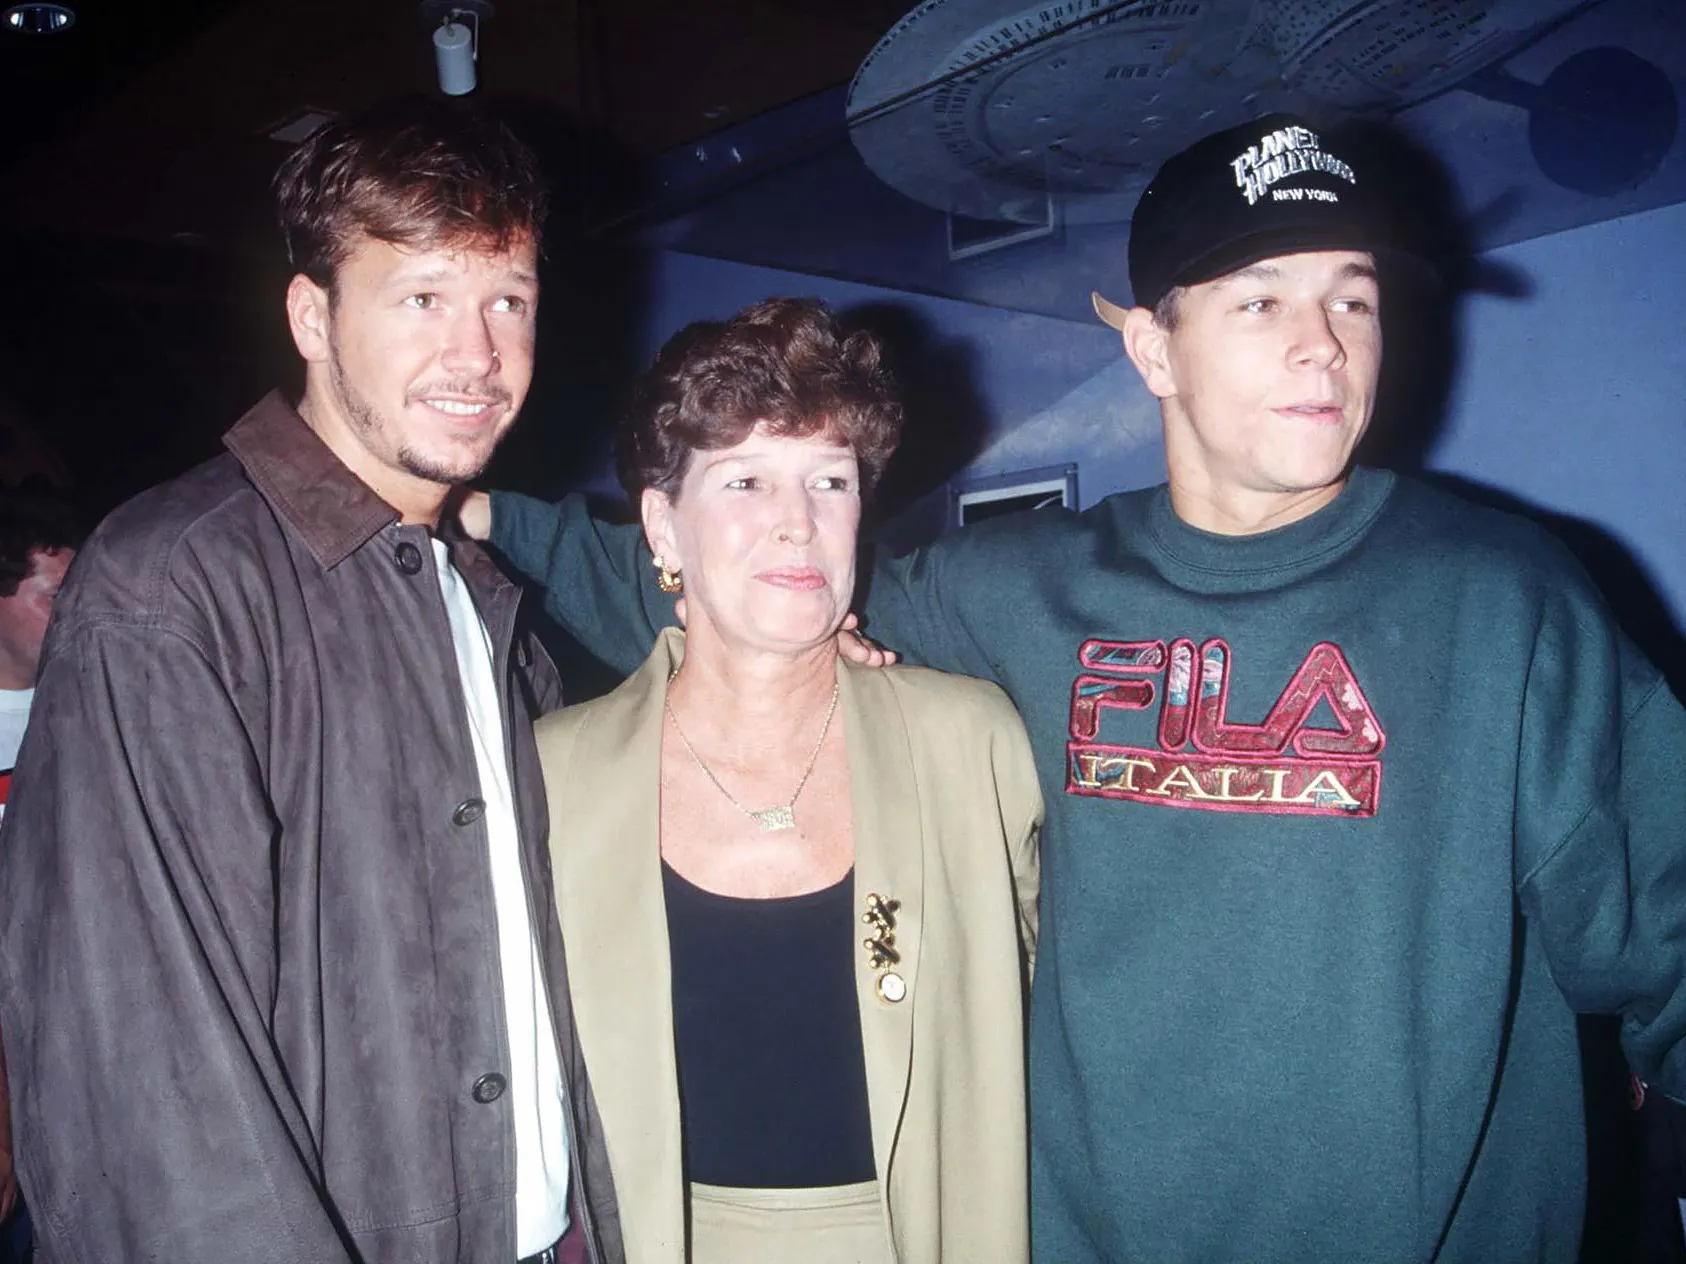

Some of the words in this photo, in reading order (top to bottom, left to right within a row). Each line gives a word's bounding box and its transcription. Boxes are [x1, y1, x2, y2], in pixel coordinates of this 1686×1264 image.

[1273, 188, 1303, 201] NEW
[1305, 188, 1339, 202] YORK
[1070, 637, 1387, 758] FILA
[1078, 754, 1362, 806] ITALIA
